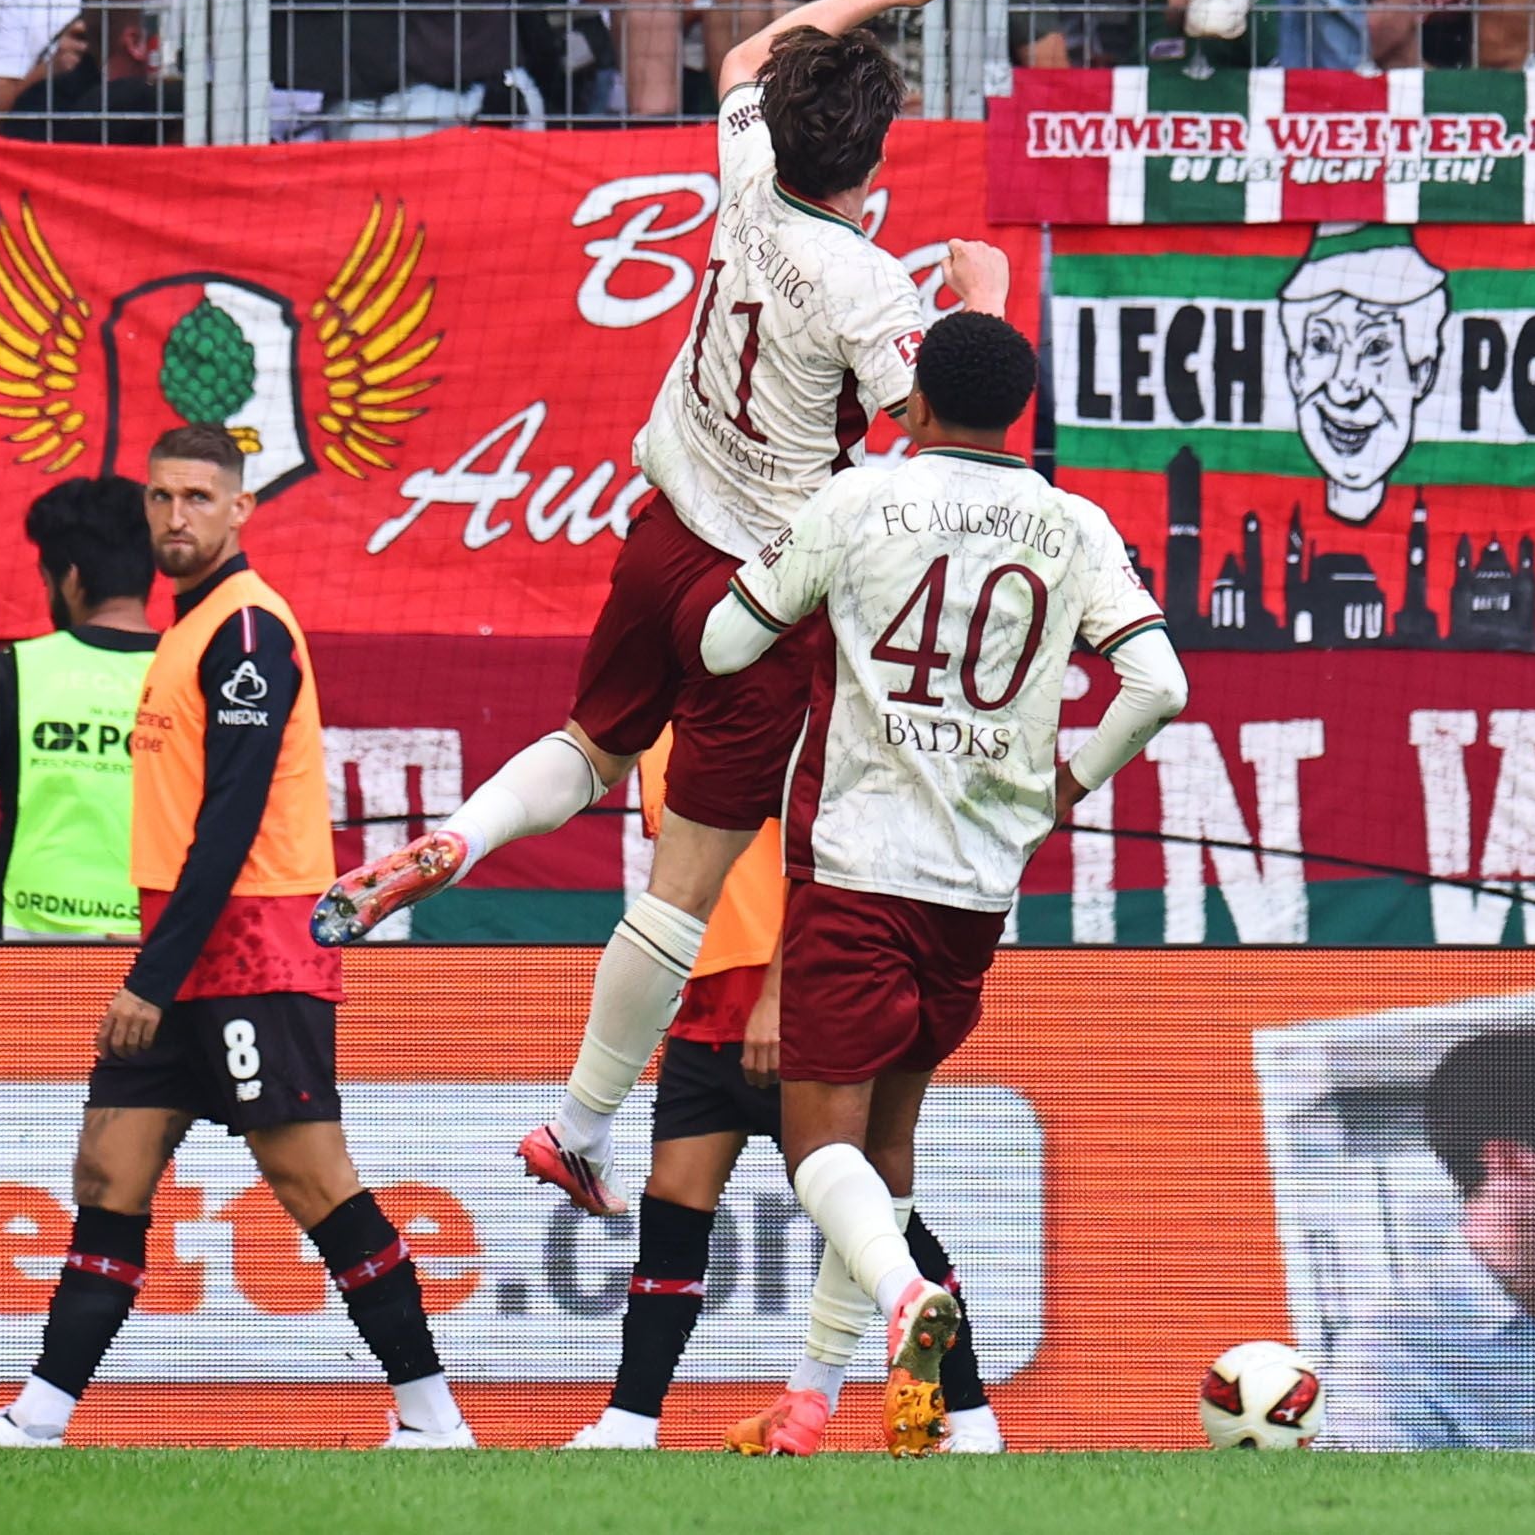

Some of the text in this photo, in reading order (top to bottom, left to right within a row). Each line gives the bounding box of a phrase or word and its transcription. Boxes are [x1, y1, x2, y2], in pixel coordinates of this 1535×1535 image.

[1028, 112, 1247, 158] IMMER
[1169, 156, 1495, 184] DU BIST NICHT ALLEIN!
[689, 259, 768, 445] 11
[1076, 306, 1264, 424] LECH
[881, 501, 1066, 559] FC AUGSBURG
[869, 553, 1049, 712] 40
[881, 713, 1011, 761] BANKS
[223, 1017, 261, 1080] 8
